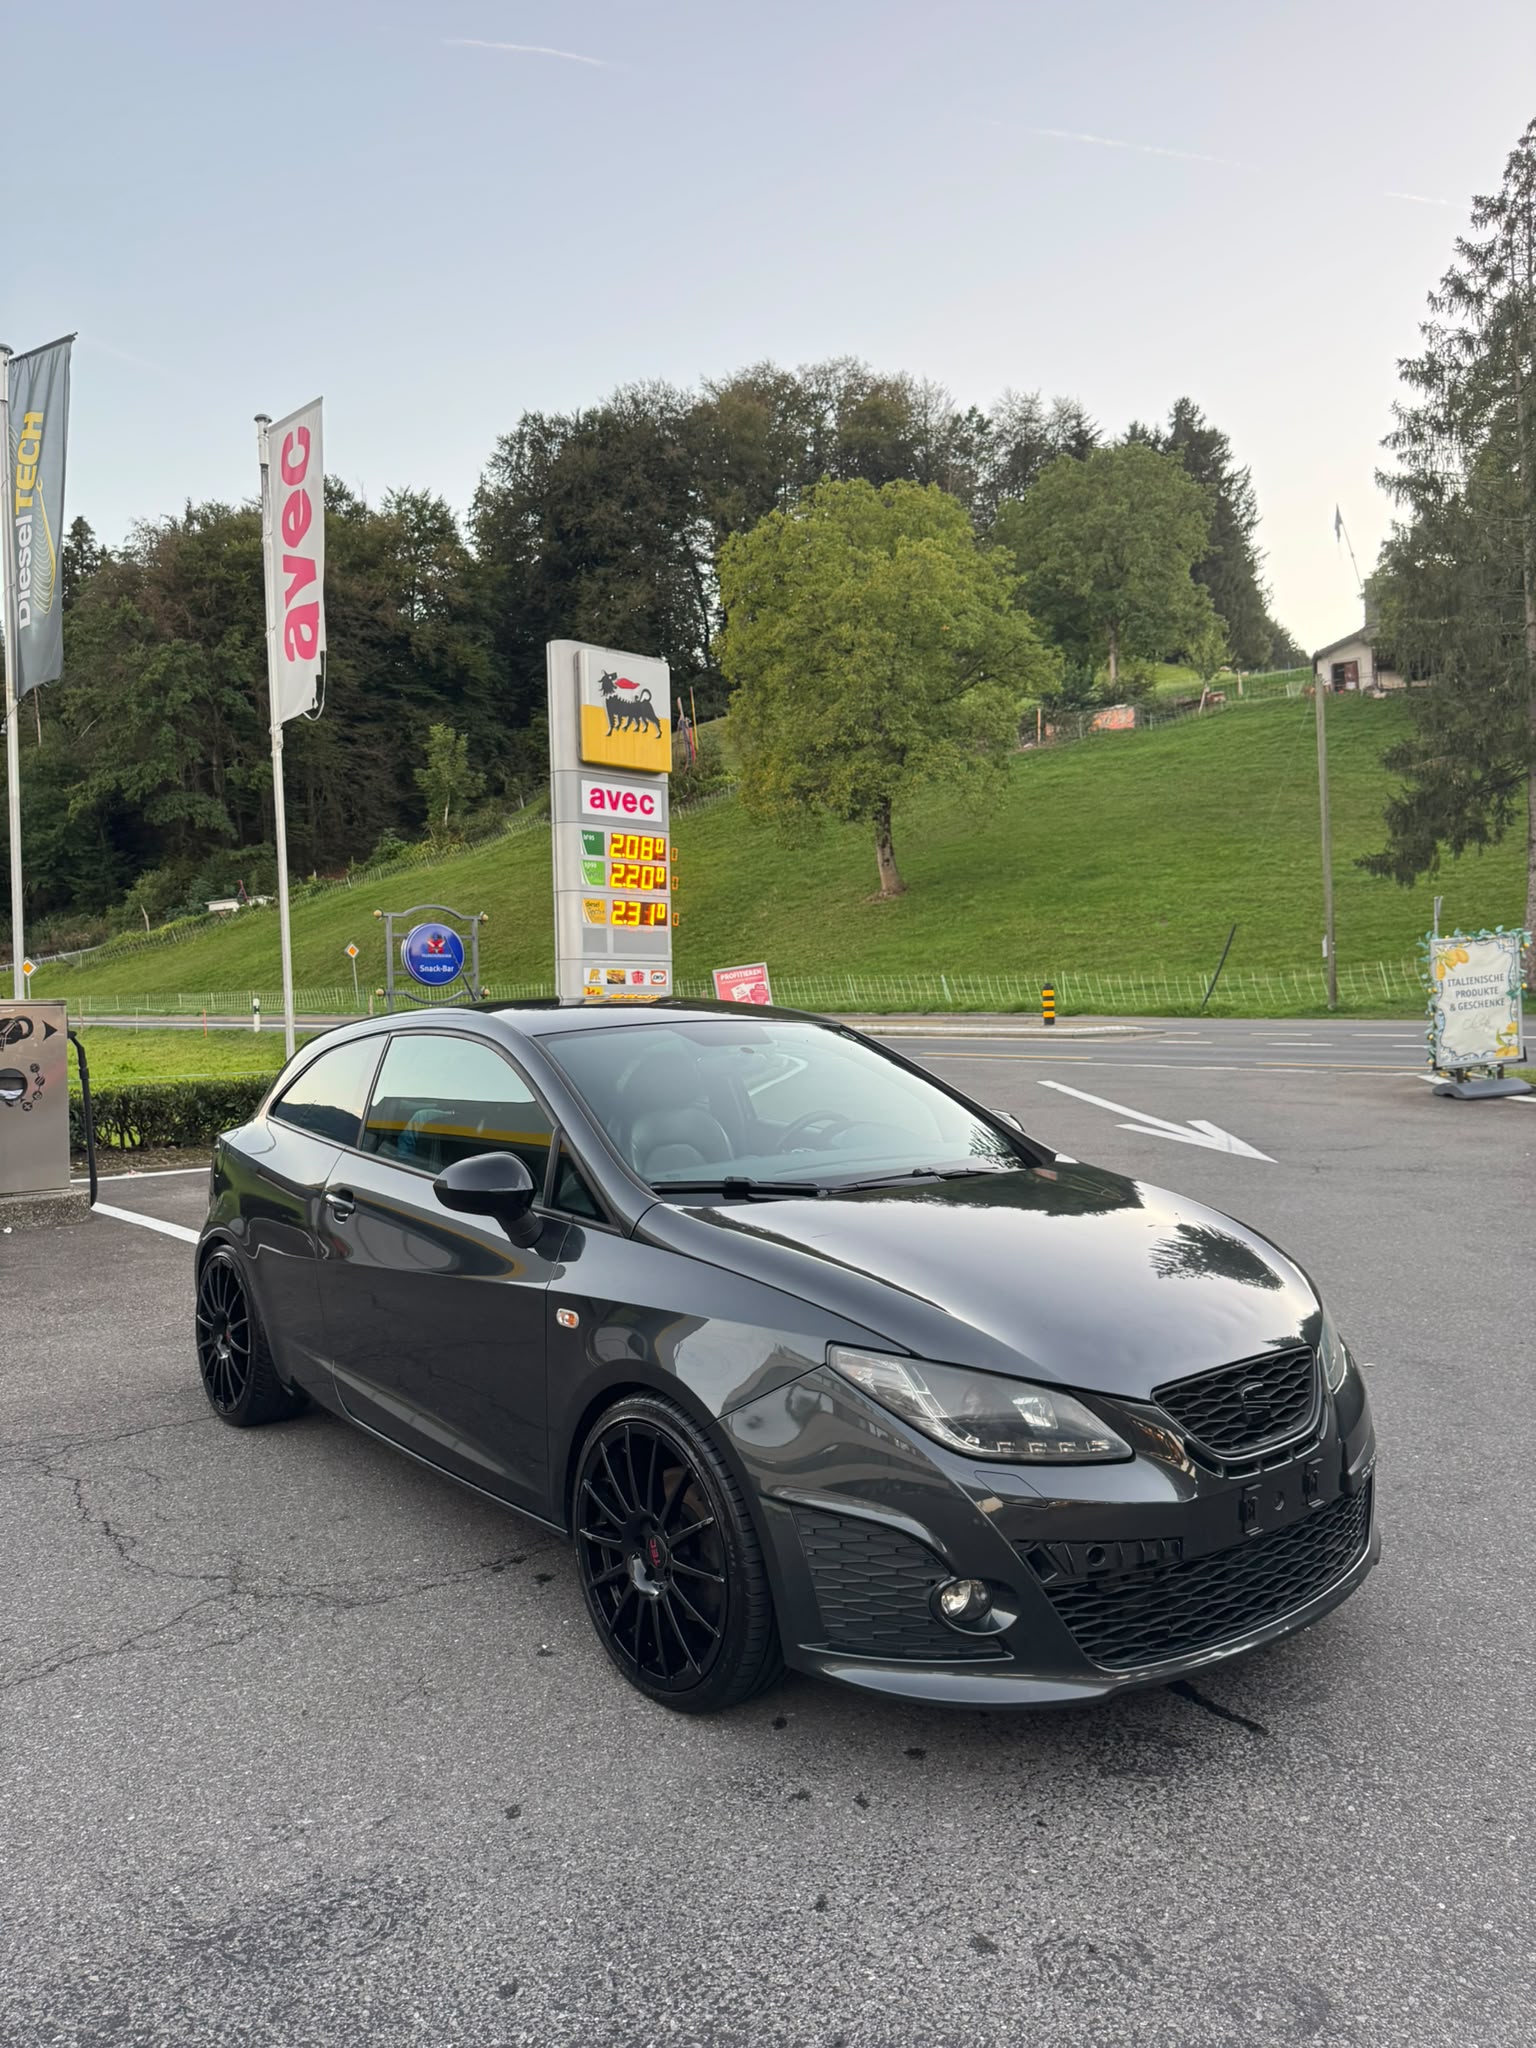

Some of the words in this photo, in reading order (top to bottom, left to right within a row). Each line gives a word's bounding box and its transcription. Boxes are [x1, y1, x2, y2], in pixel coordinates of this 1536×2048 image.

[281, 425, 320, 662] avec
[589, 787, 655, 815] avec
[419, 964, 454, 973] Snack-Bar
[1447, 973, 1505, 987] ITALIENISCHE
[1455, 986, 1499, 998] PRODUKTE
[1449, 1003, 1456, 1012] &
[1458, 998, 1505, 1011] GESCHENKE
